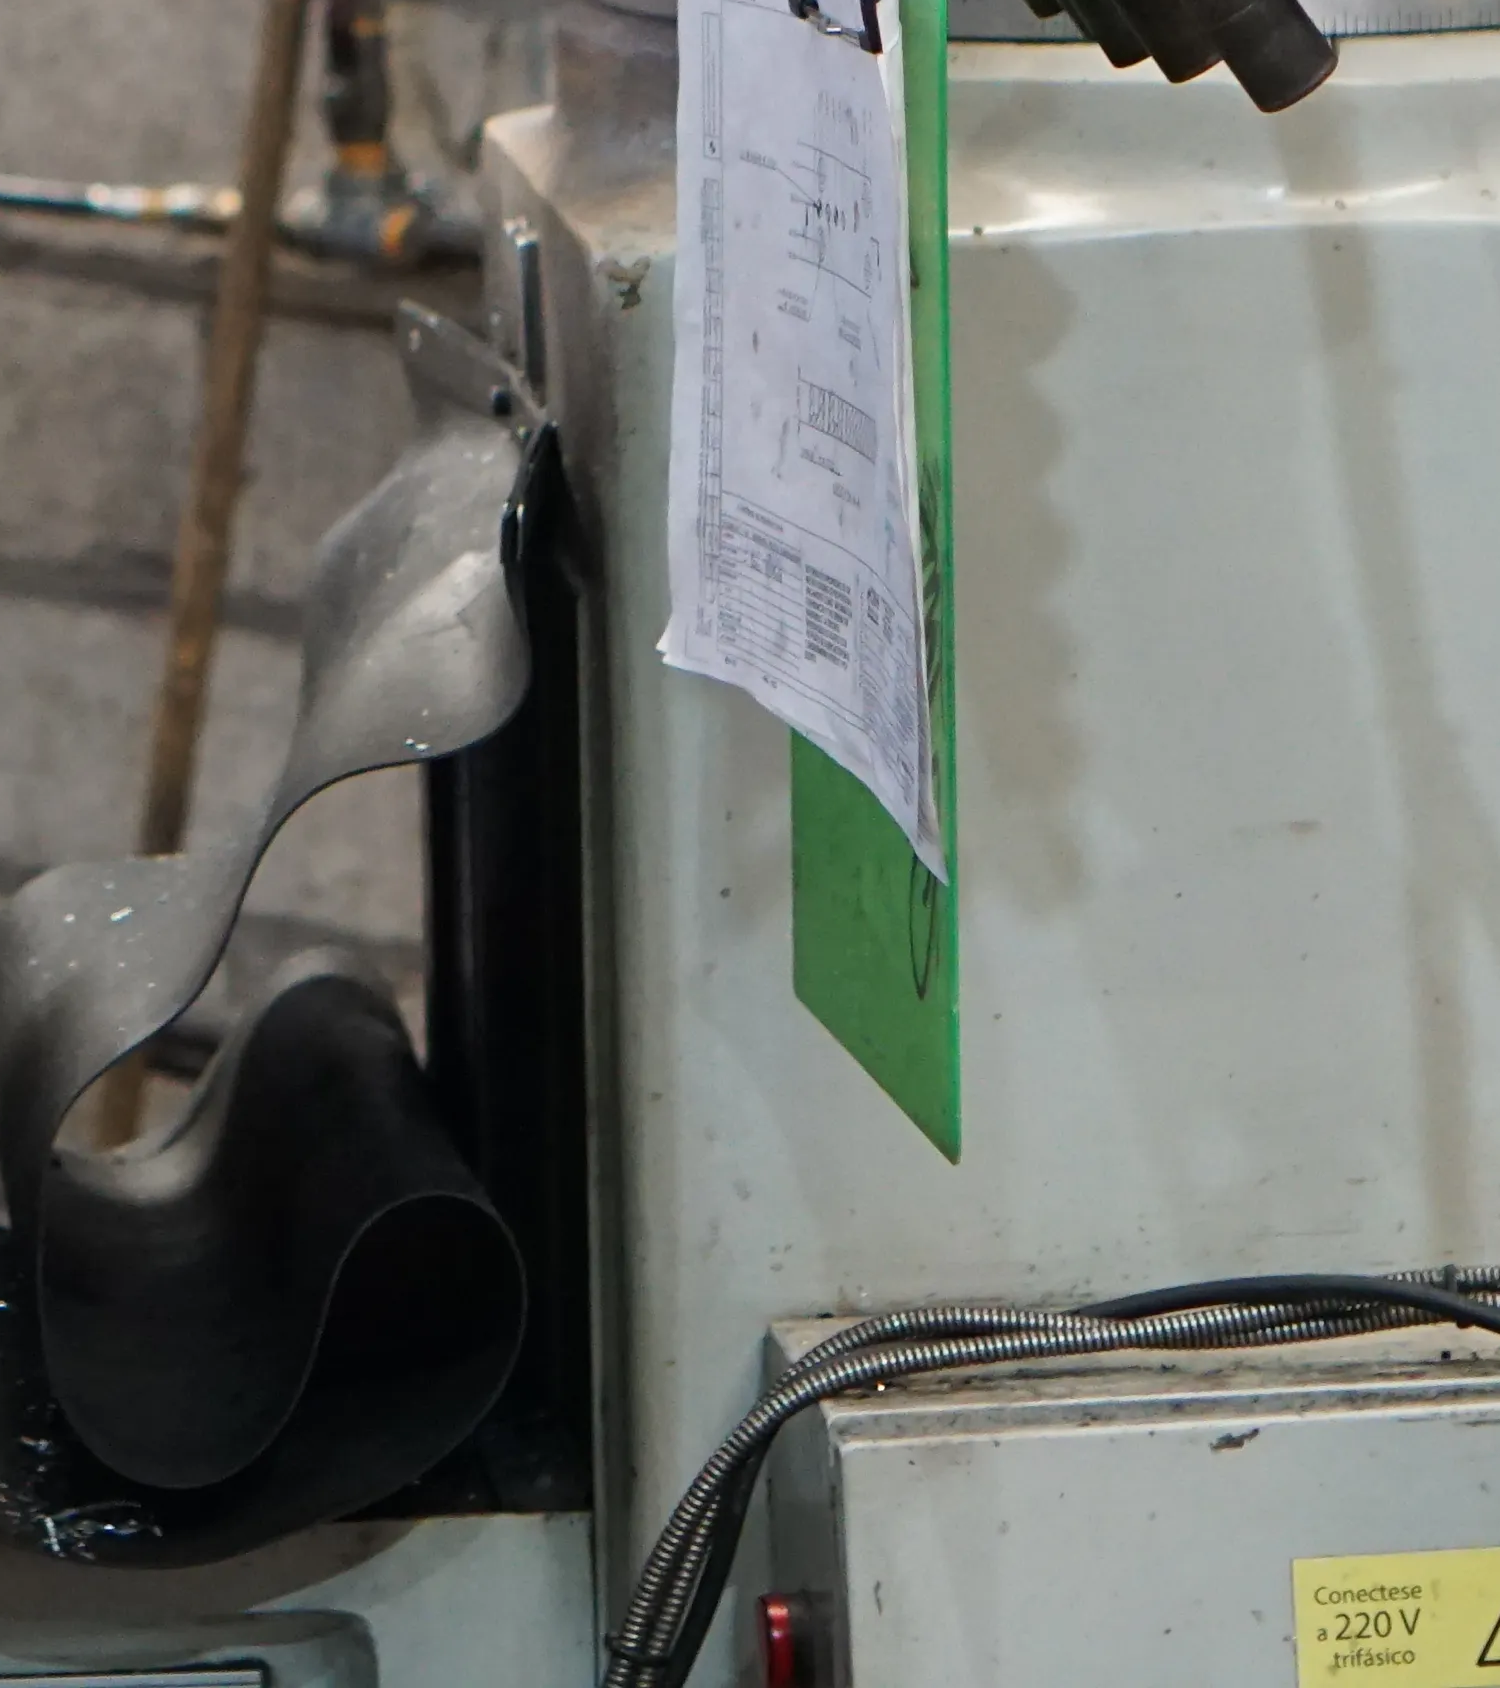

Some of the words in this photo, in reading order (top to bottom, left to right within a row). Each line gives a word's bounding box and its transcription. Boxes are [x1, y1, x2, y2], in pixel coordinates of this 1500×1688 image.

[1313, 1583, 1424, 1607] Conectese
[1316, 1626, 1329, 1643] a
[1334, 1610, 1394, 1642] 220
[1398, 1608, 1421, 1637] V
[1332, 1646, 1416, 1670] trifásico
